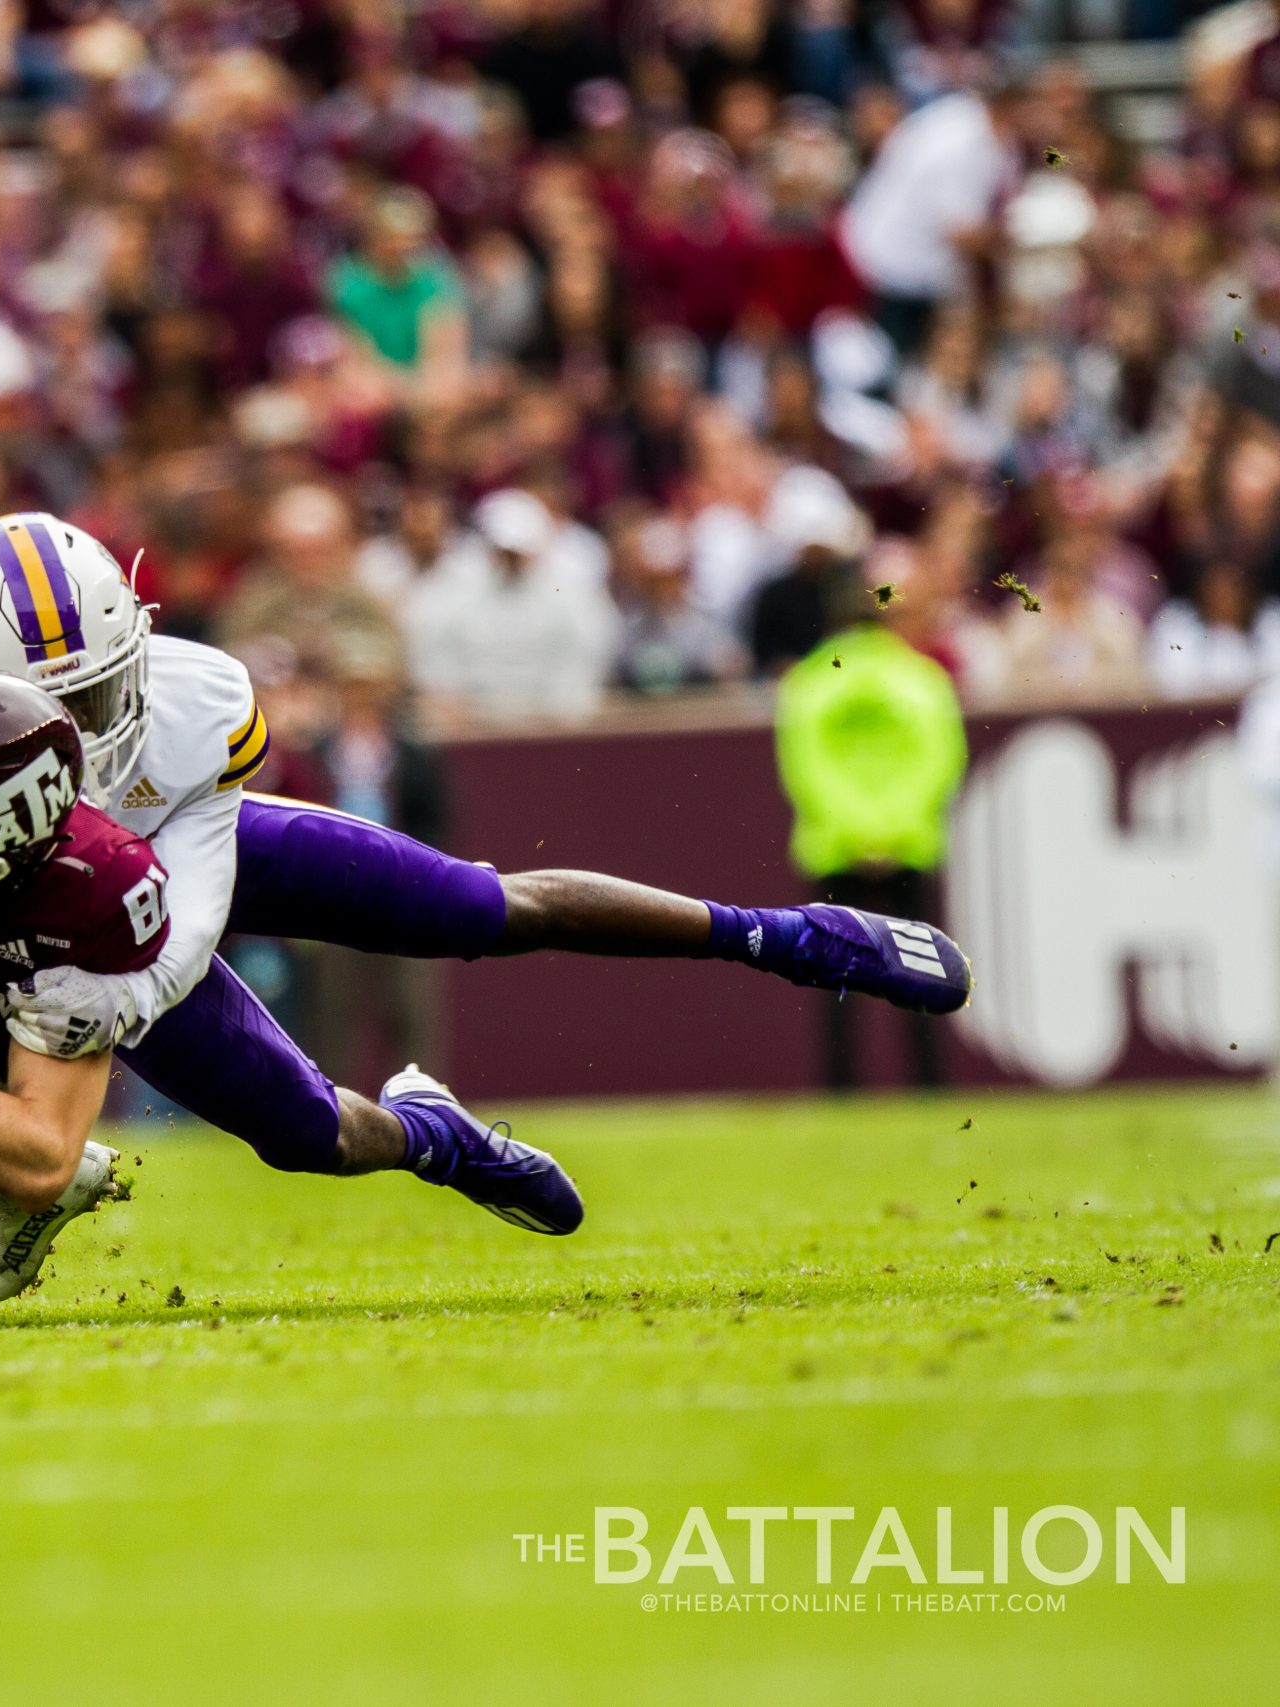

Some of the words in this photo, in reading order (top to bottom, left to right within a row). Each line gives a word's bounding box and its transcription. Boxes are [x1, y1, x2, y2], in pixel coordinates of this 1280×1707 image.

[121, 797, 168, 810] adidas
[36, 934, 71, 949] UNIFIED
[58, 1018, 102, 1056] adidas
